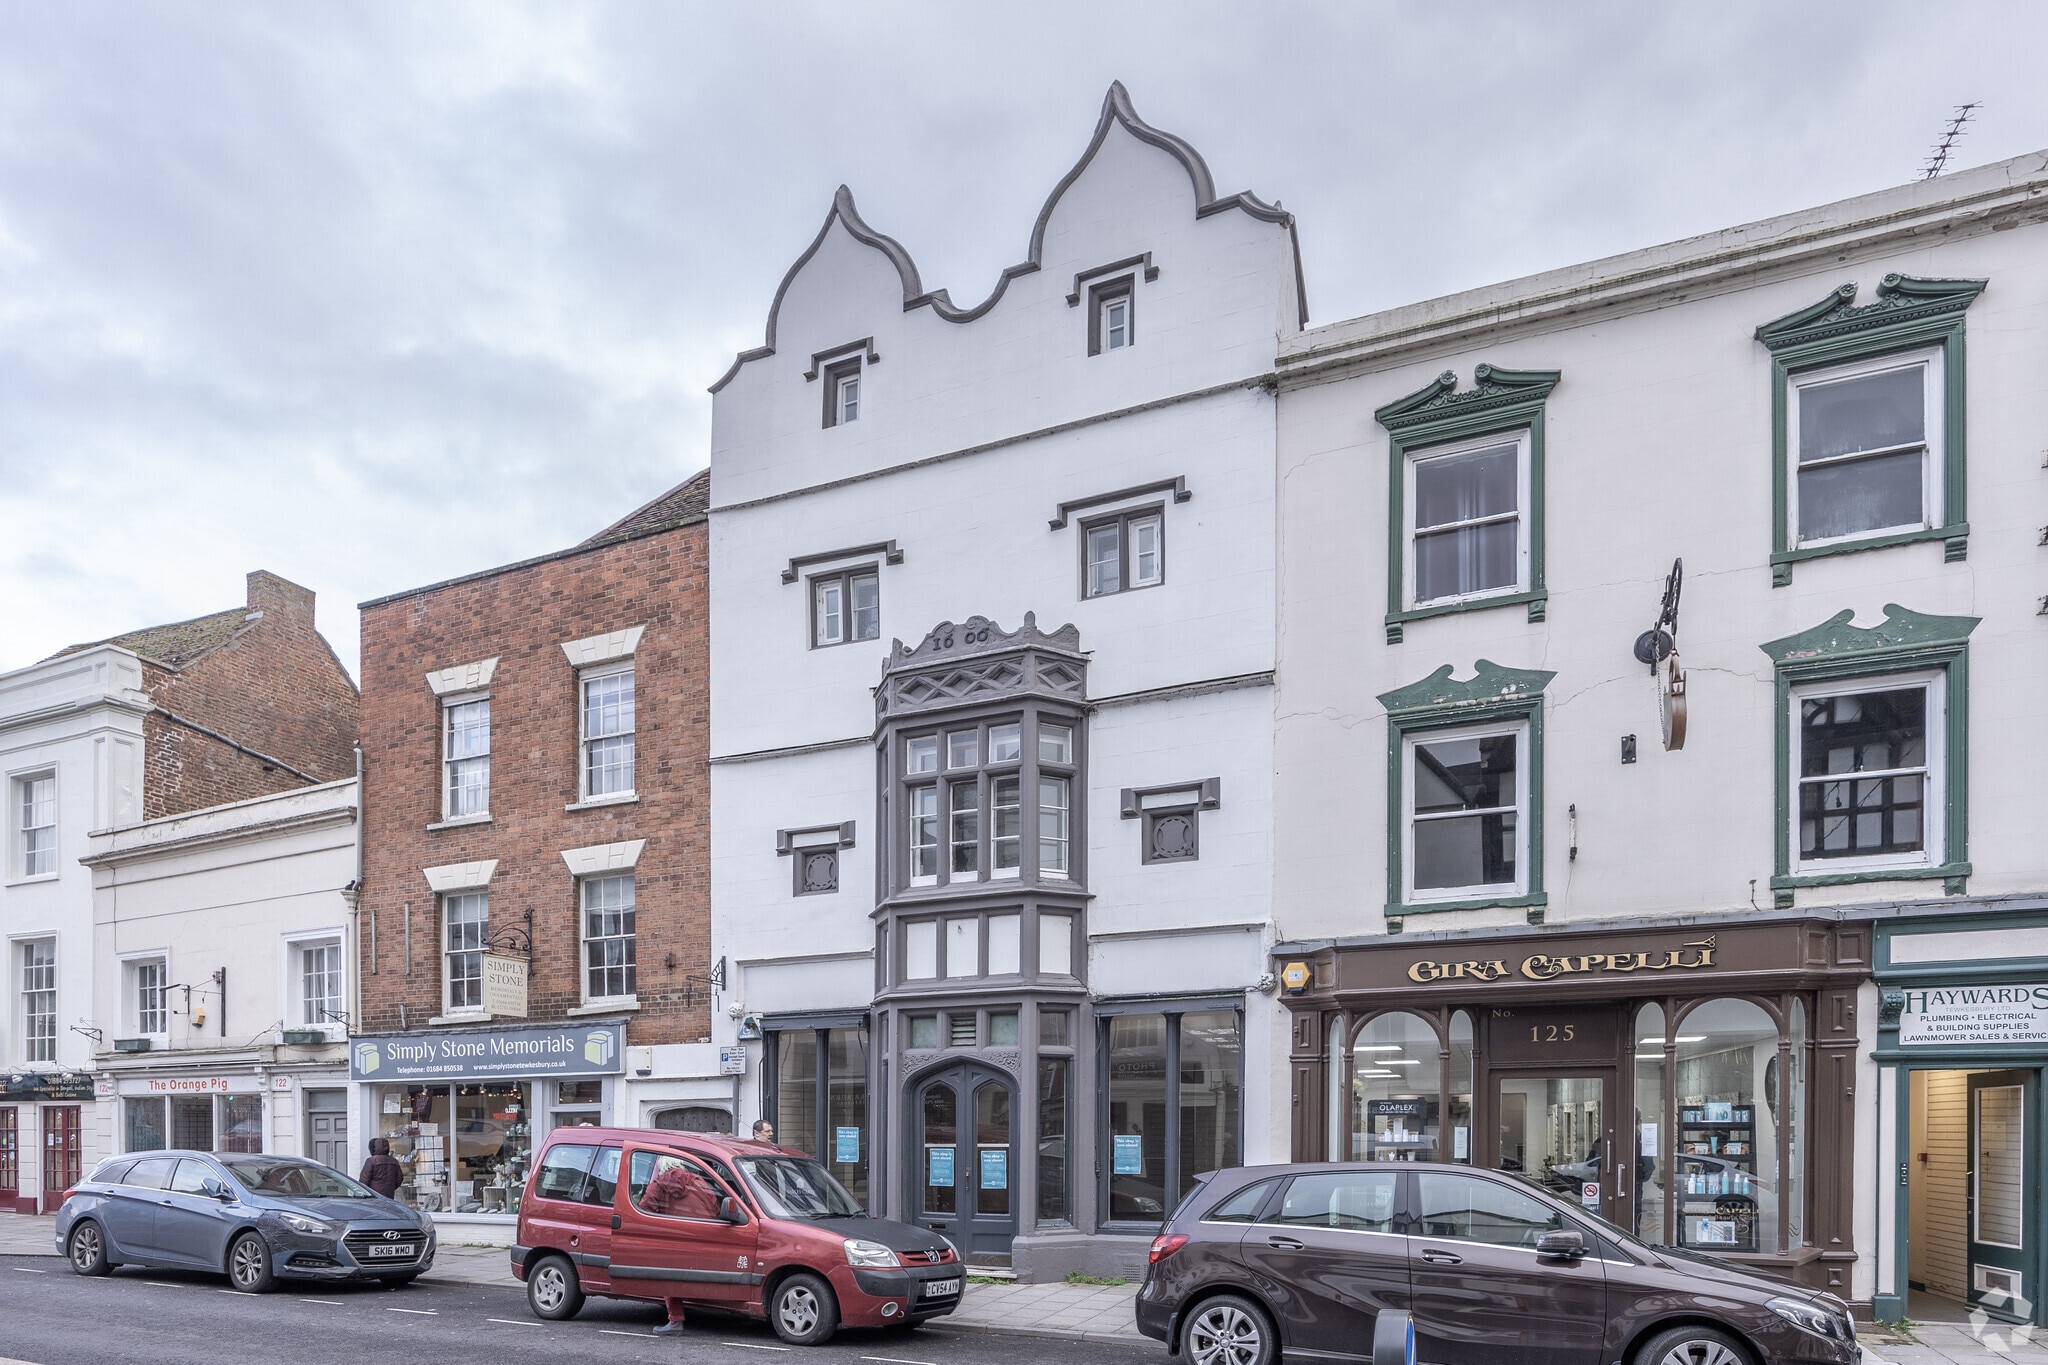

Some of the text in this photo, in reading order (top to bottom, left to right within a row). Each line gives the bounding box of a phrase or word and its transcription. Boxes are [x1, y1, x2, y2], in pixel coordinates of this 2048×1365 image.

[487, 960, 525, 975] SIMPLY
[1406, 946, 1717, 983] GIRA CAPELLI
[489, 973, 524, 987] STONE
[1904, 986, 2048, 1014] HAYWARDS
[1919, 1012, 2037, 1022] PLUMBING ELECTRICAL
[1530, 1024, 1576, 1043] 125
[1936, 1023, 1981, 1031] BUILDING
[1983, 1022, 2030, 1030] SUPPLIES
[1903, 1033, 1967, 1042] LAWNMOWER
[1969, 1033, 2001, 1041] SALES
[2002, 1032, 2010, 1040] &
[387, 1034, 575, 1063] Simply Stone Memorials
[396, 1059, 567, 1075] Telephone: 01684 850538 www.simplystonetewkesbury.co.uk
[149, 1077, 228, 1092] The Orange Pig
[275, 1078, 287, 1088] 122
[374, 1246, 393, 1256] SK16
[931, 1282, 948, 1295] CV54
